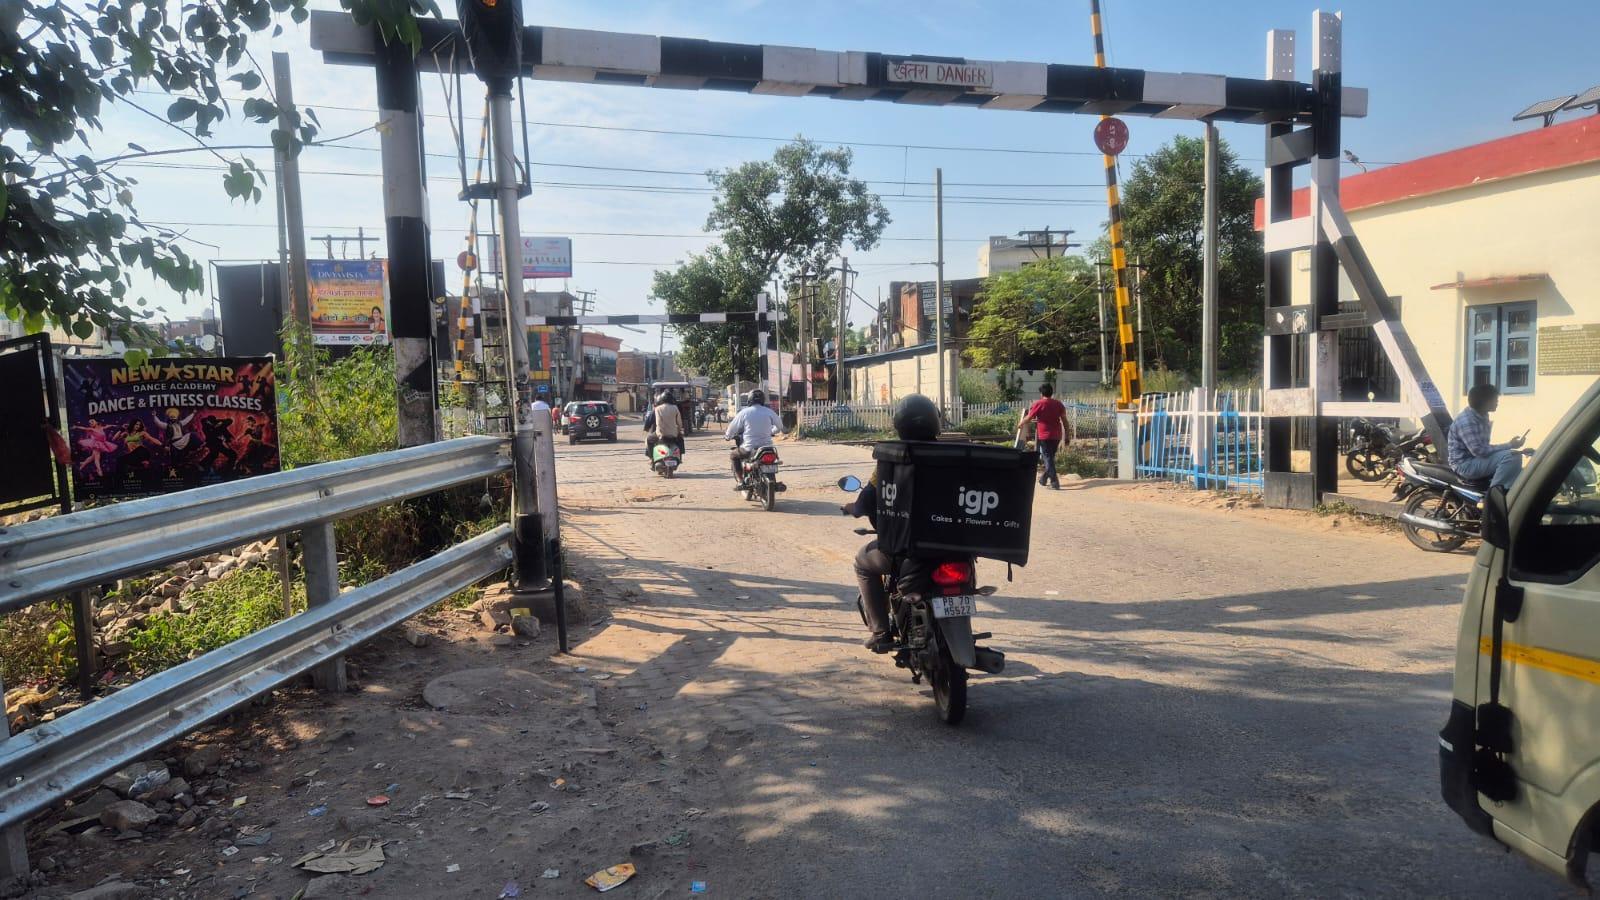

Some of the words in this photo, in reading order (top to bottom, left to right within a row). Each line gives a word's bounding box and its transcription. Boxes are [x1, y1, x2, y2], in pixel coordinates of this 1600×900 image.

[893, 63, 928, 80] खतरा
[936, 64, 986, 84] DANGER
[111, 364, 161, 385] NEW
[183, 364, 235, 383] STAR
[133, 383, 167, 393] DANCE
[169, 383, 217, 391] ACADEMY
[88, 397, 135, 415] DANCE
[138, 398, 146, 408] &
[149, 394, 205, 408] FITNESS
[206, 396, 262, 411] CLASSES
[881, 480, 897, 507] igp
[958, 486, 999, 515] igp
[931, 515, 953, 523] Cakes
[965, 518, 992, 526] Flowers
[1003, 520, 1020, 528] Gifts
[943, 597, 954, 607] PB
